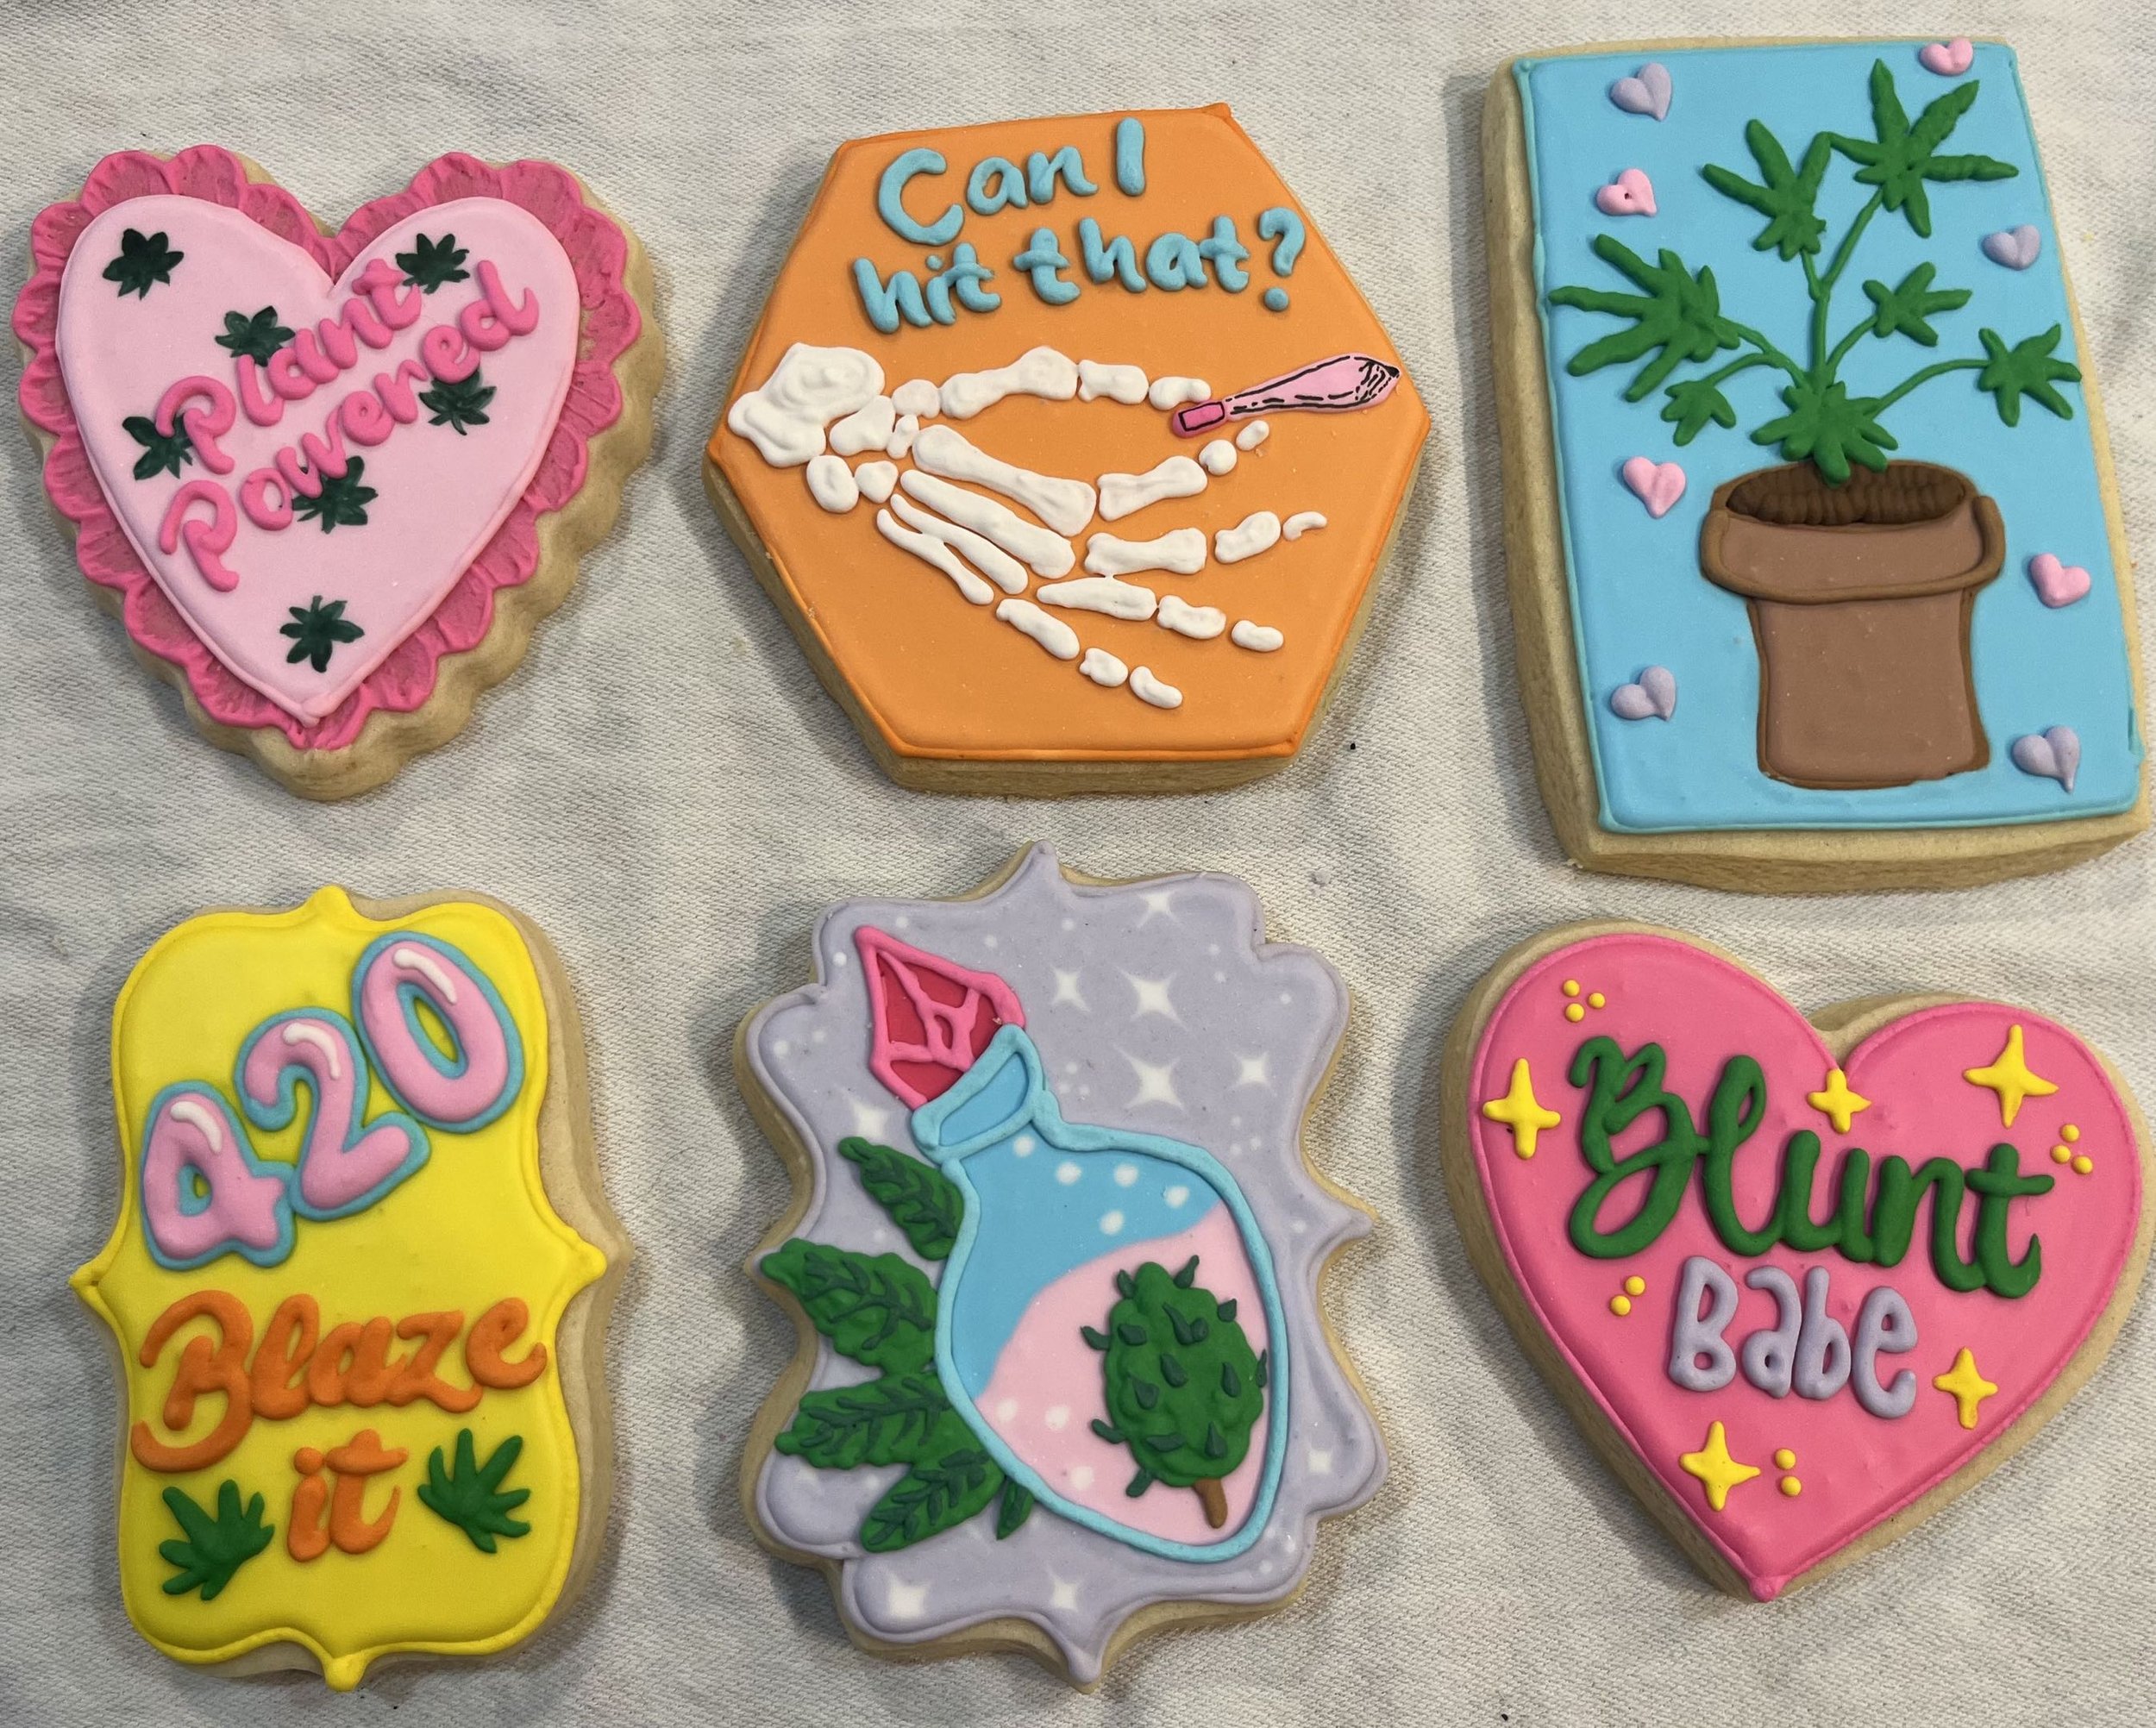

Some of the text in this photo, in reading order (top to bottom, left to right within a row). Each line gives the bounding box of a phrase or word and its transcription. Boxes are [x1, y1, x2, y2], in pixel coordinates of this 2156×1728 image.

[854, 207, 1306, 334] hit that?
[879, 117, 1145, 246] Can I
[155, 259, 422, 474] Plant
[160, 260, 539, 592] Powered
[141, 930, 525, 1270] 420
[1569, 1036, 2055, 1299] Blunt
[131, 1290, 548, 1472] Blaze
[1668, 1256, 1916, 1418] Babe
[287, 1428, 408, 1562] it
